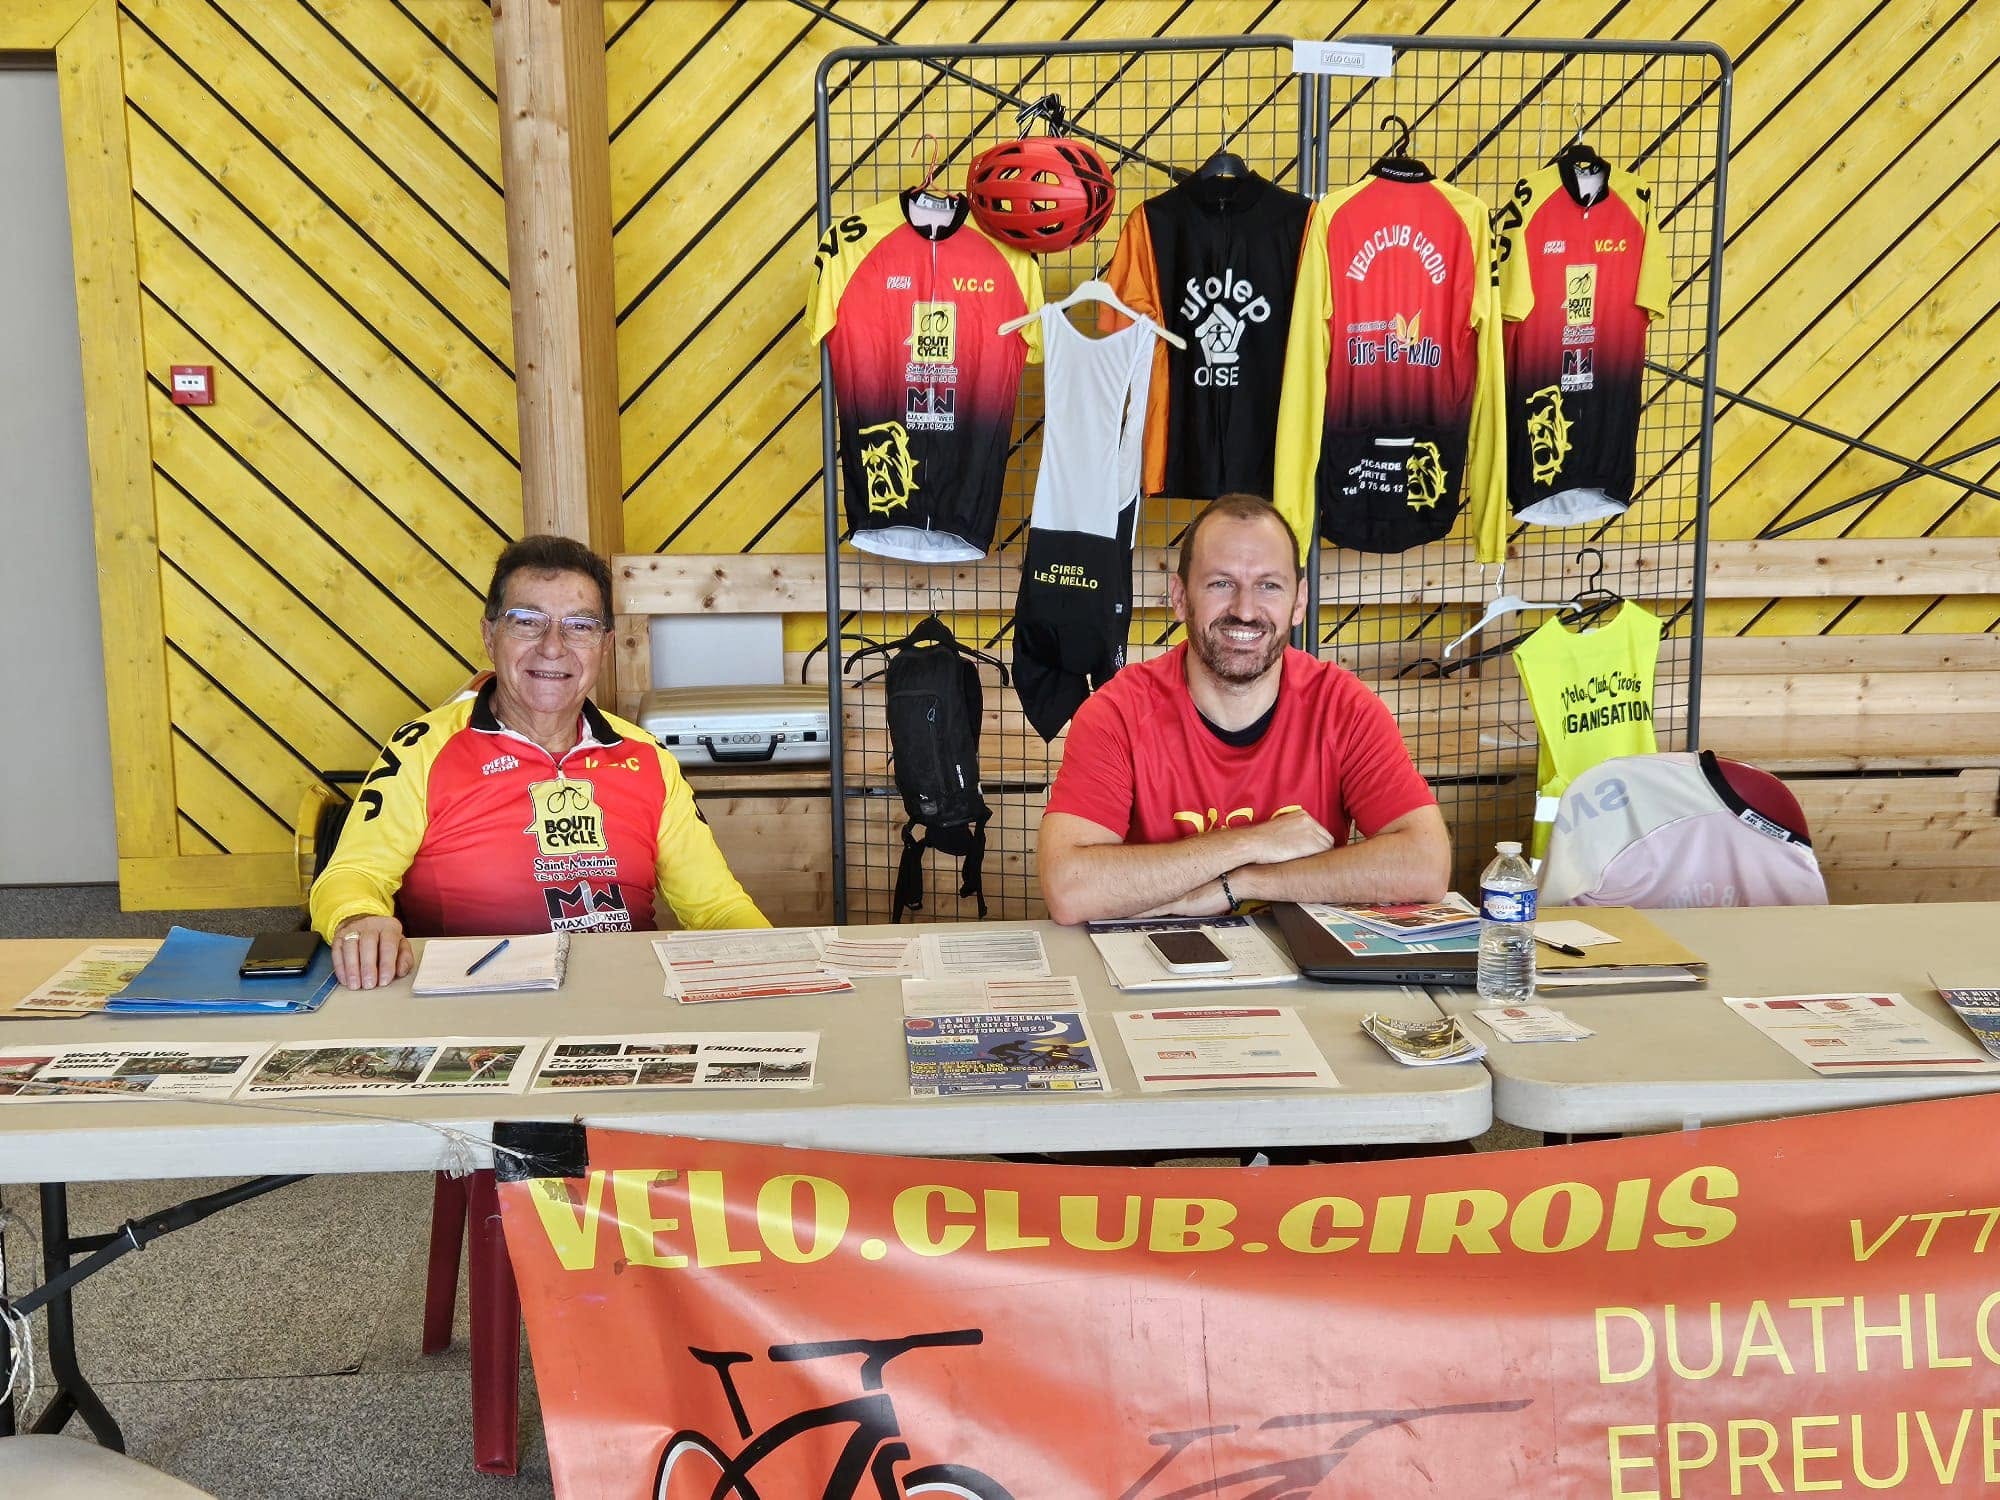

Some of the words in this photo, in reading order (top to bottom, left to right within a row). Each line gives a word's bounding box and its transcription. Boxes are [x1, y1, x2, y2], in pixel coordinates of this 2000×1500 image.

[1346, 240, 1376, 282] VELO
[1374, 225, 1412, 251] CLUB
[1413, 231, 1447, 285] CIROIS
[1180, 268, 1271, 323] ufolep
[917, 335, 949, 346] BOUTI
[917, 346, 949, 357] CYCLE
[1194, 366, 1240, 387] OISE
[1361, 459, 1402, 471] PICARDE
[1051, 564, 1084, 576] CIRES
[1034, 570, 1056, 583] LES
[1060, 575, 1098, 589] MELLO
[544, 815, 596, 834] BOUTI
[546, 831, 599, 847] CYCLE
[703, 1045, 807, 1053] ENDURANCE
[410, 1082, 510, 1090] Cyclo-cross
